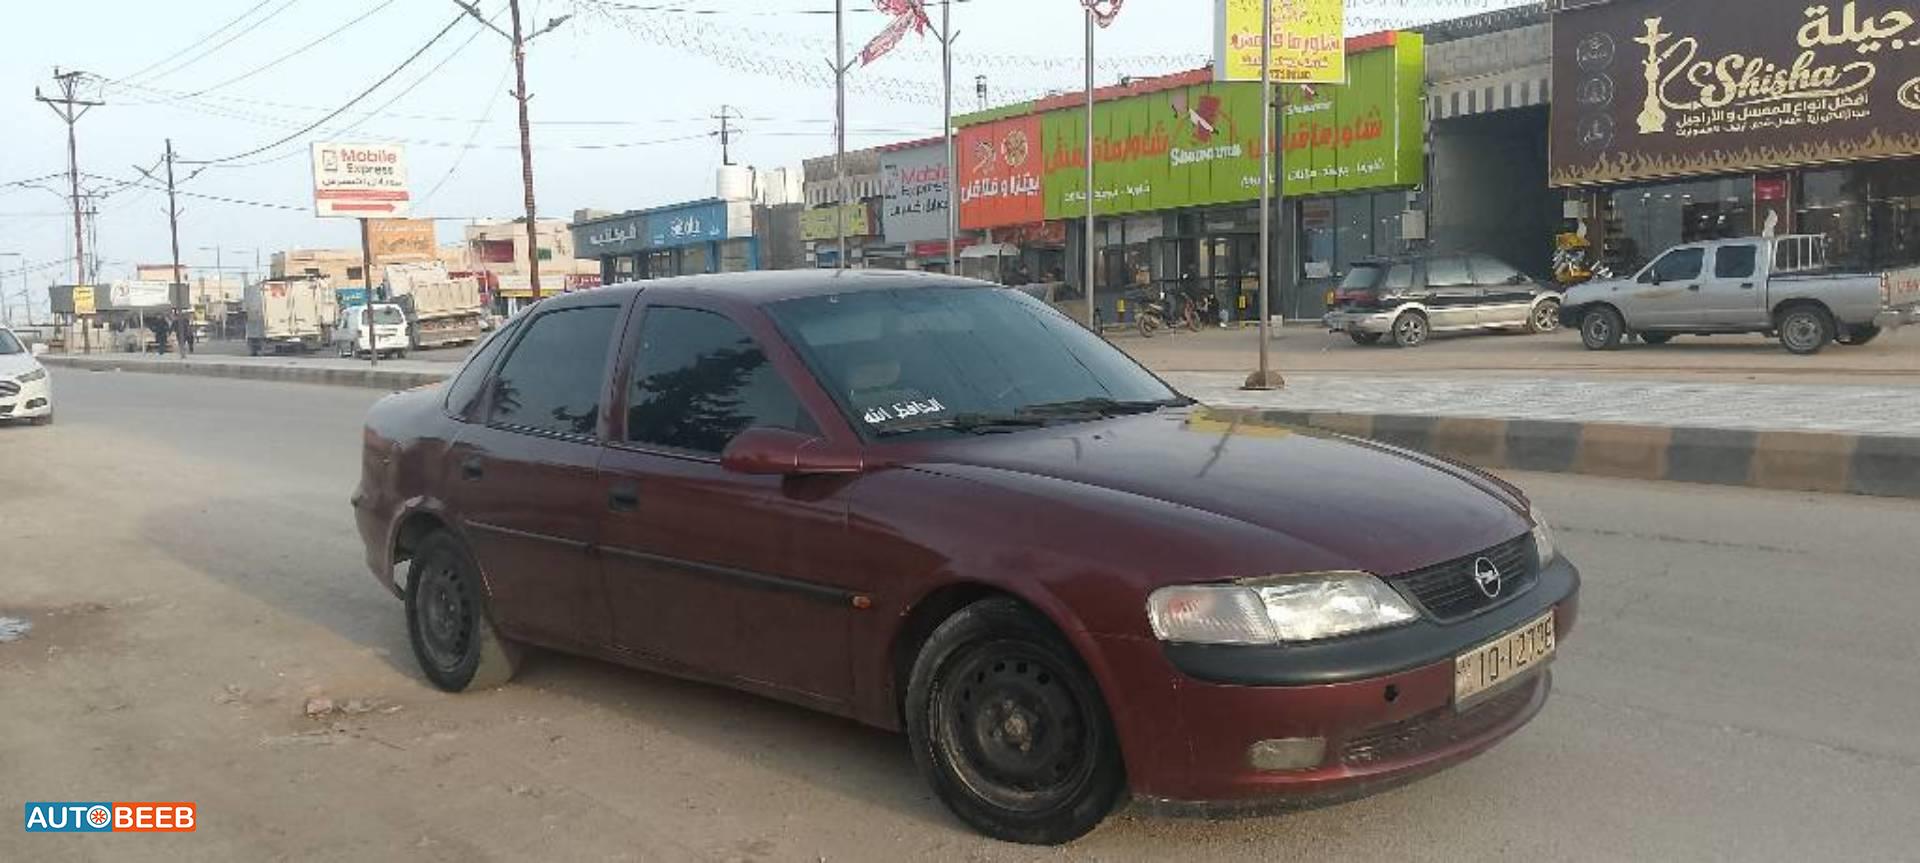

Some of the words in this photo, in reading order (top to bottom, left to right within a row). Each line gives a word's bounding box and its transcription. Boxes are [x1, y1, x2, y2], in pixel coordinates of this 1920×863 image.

[1797, 3, 1920, 54] جيلة
[1690, 50, 1846, 108] Shisha
[1726, 111, 1736, 123] و
[1310, 106, 1384, 148] شاورما
[340, 149, 397, 164] Mobile
[346, 163, 394, 175] Express
[863, 406, 893, 423] الله
